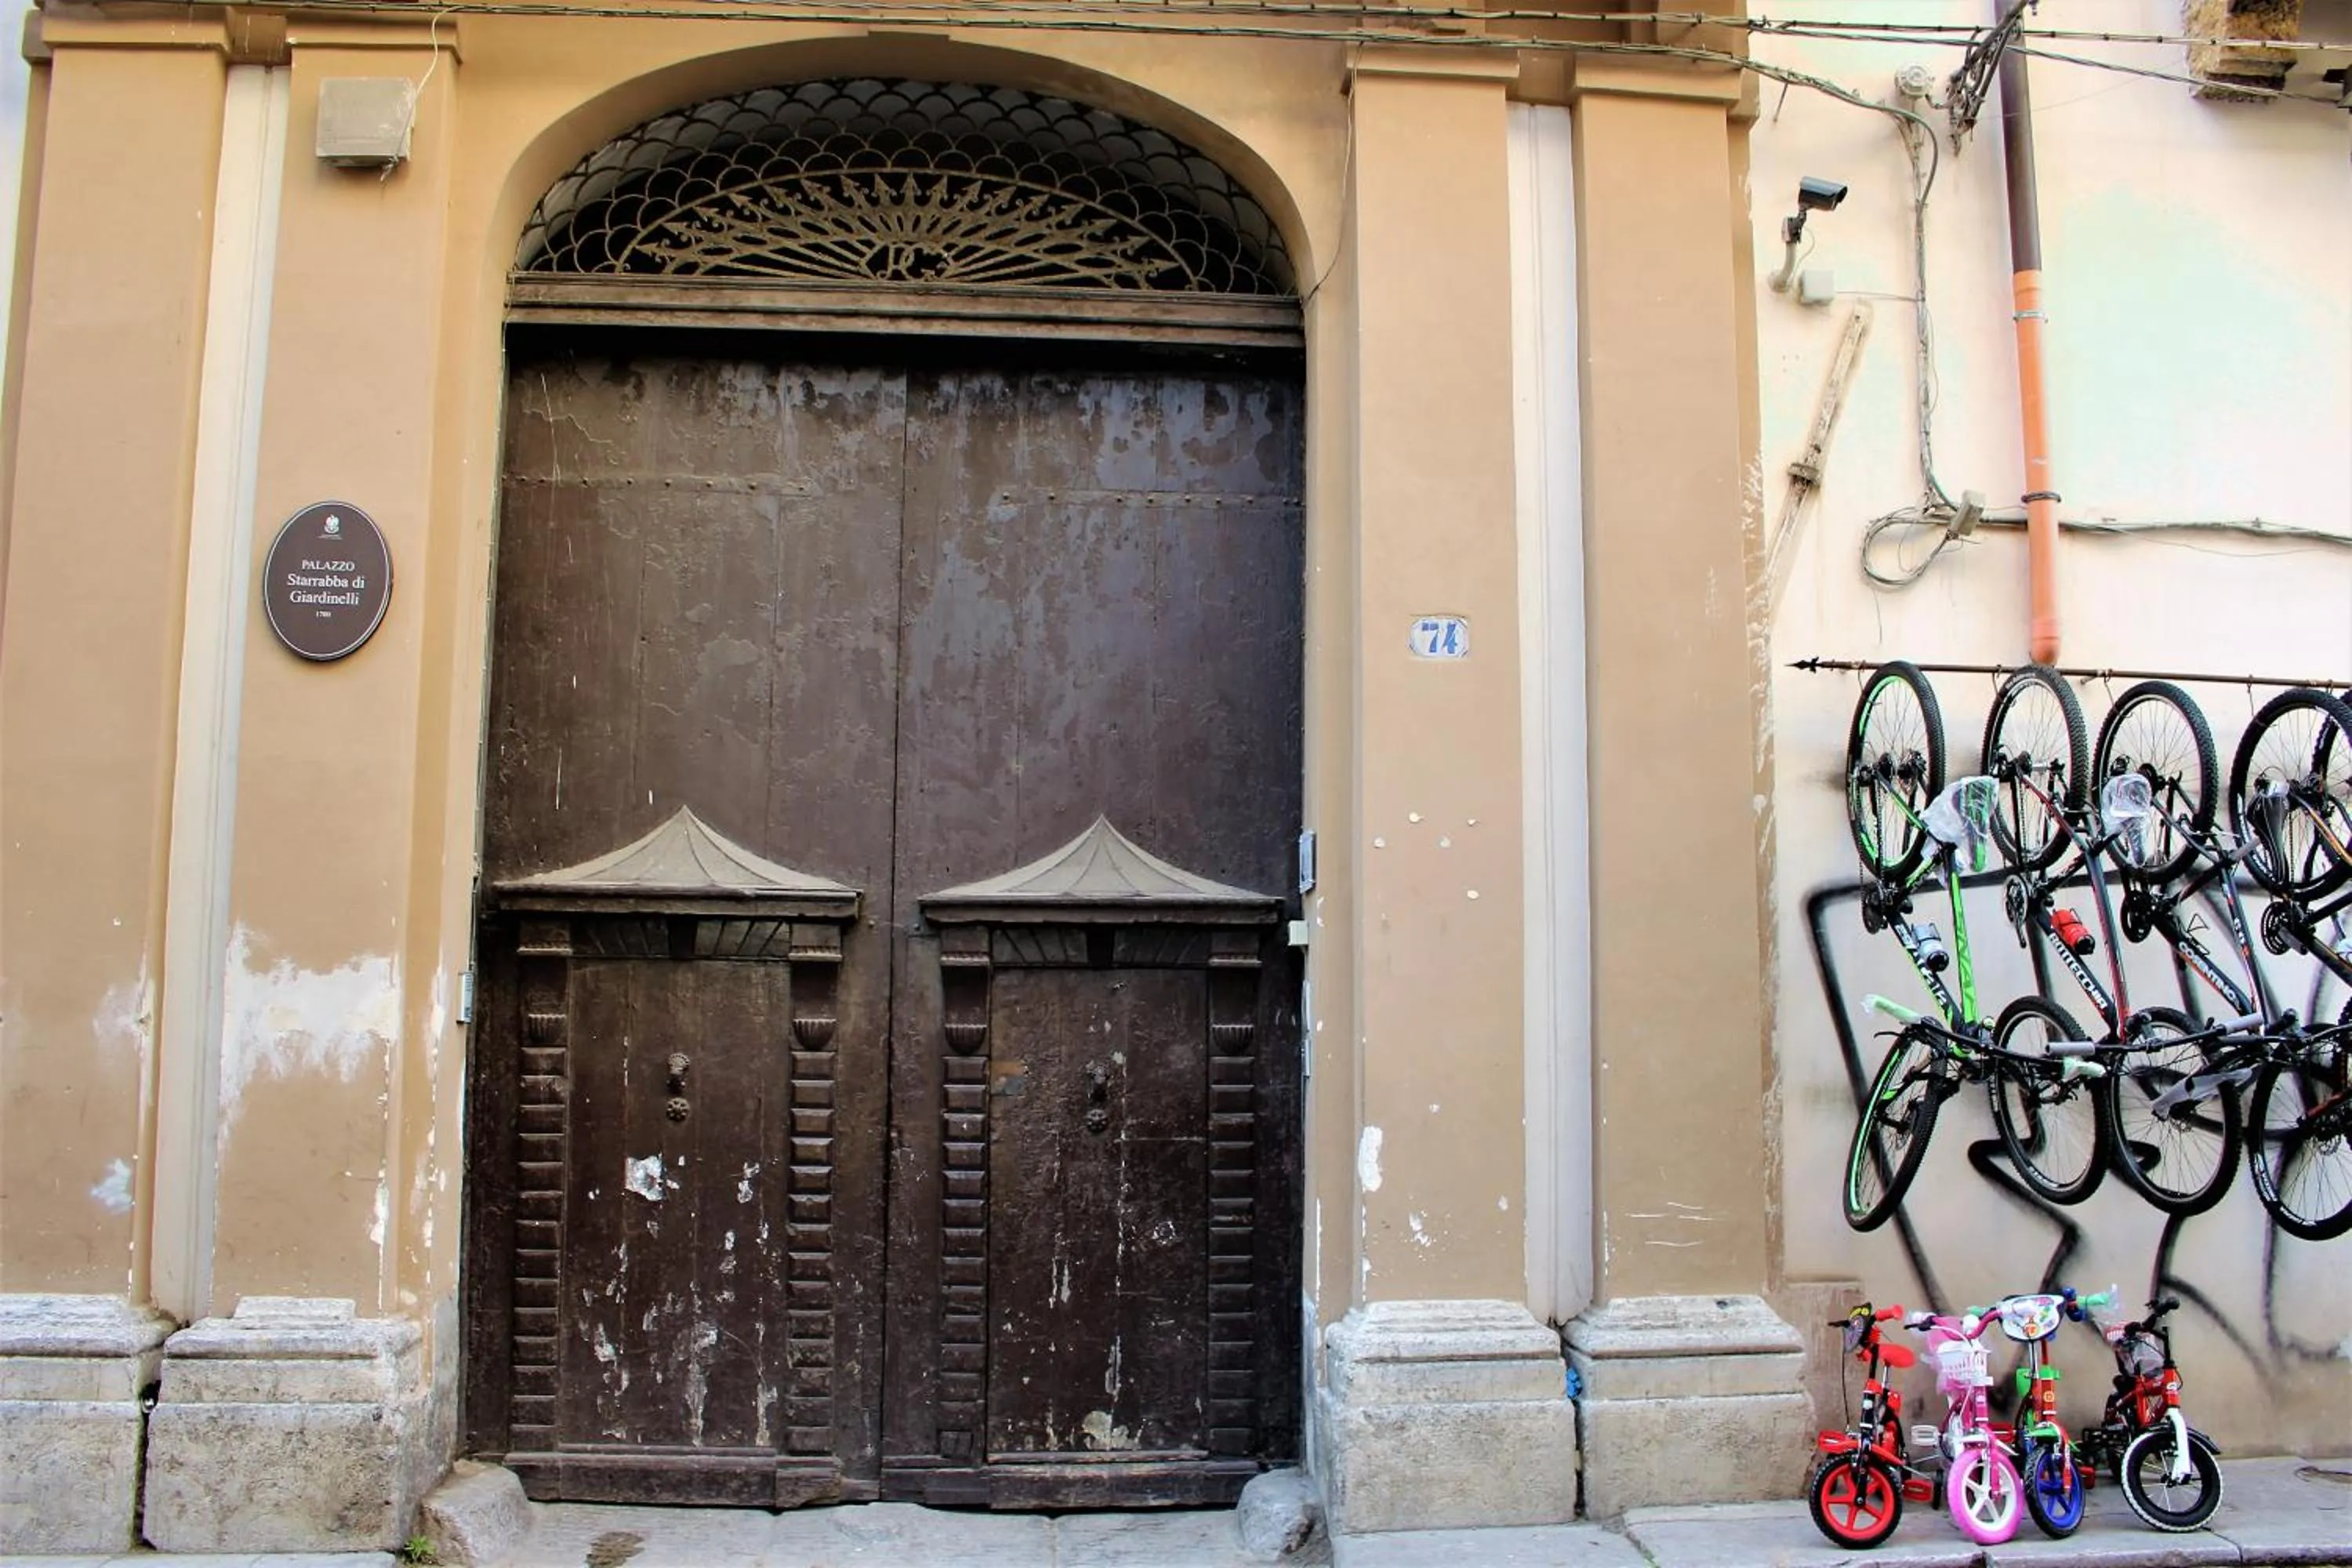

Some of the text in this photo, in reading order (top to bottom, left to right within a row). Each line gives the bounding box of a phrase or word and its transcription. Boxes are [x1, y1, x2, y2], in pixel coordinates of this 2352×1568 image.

[302, 559, 355, 572] PALAZZO
[288, 573, 365, 589] Starrabba di
[289, 590, 359, 605] Giardinelli
[1421, 622, 1457, 654] 74
